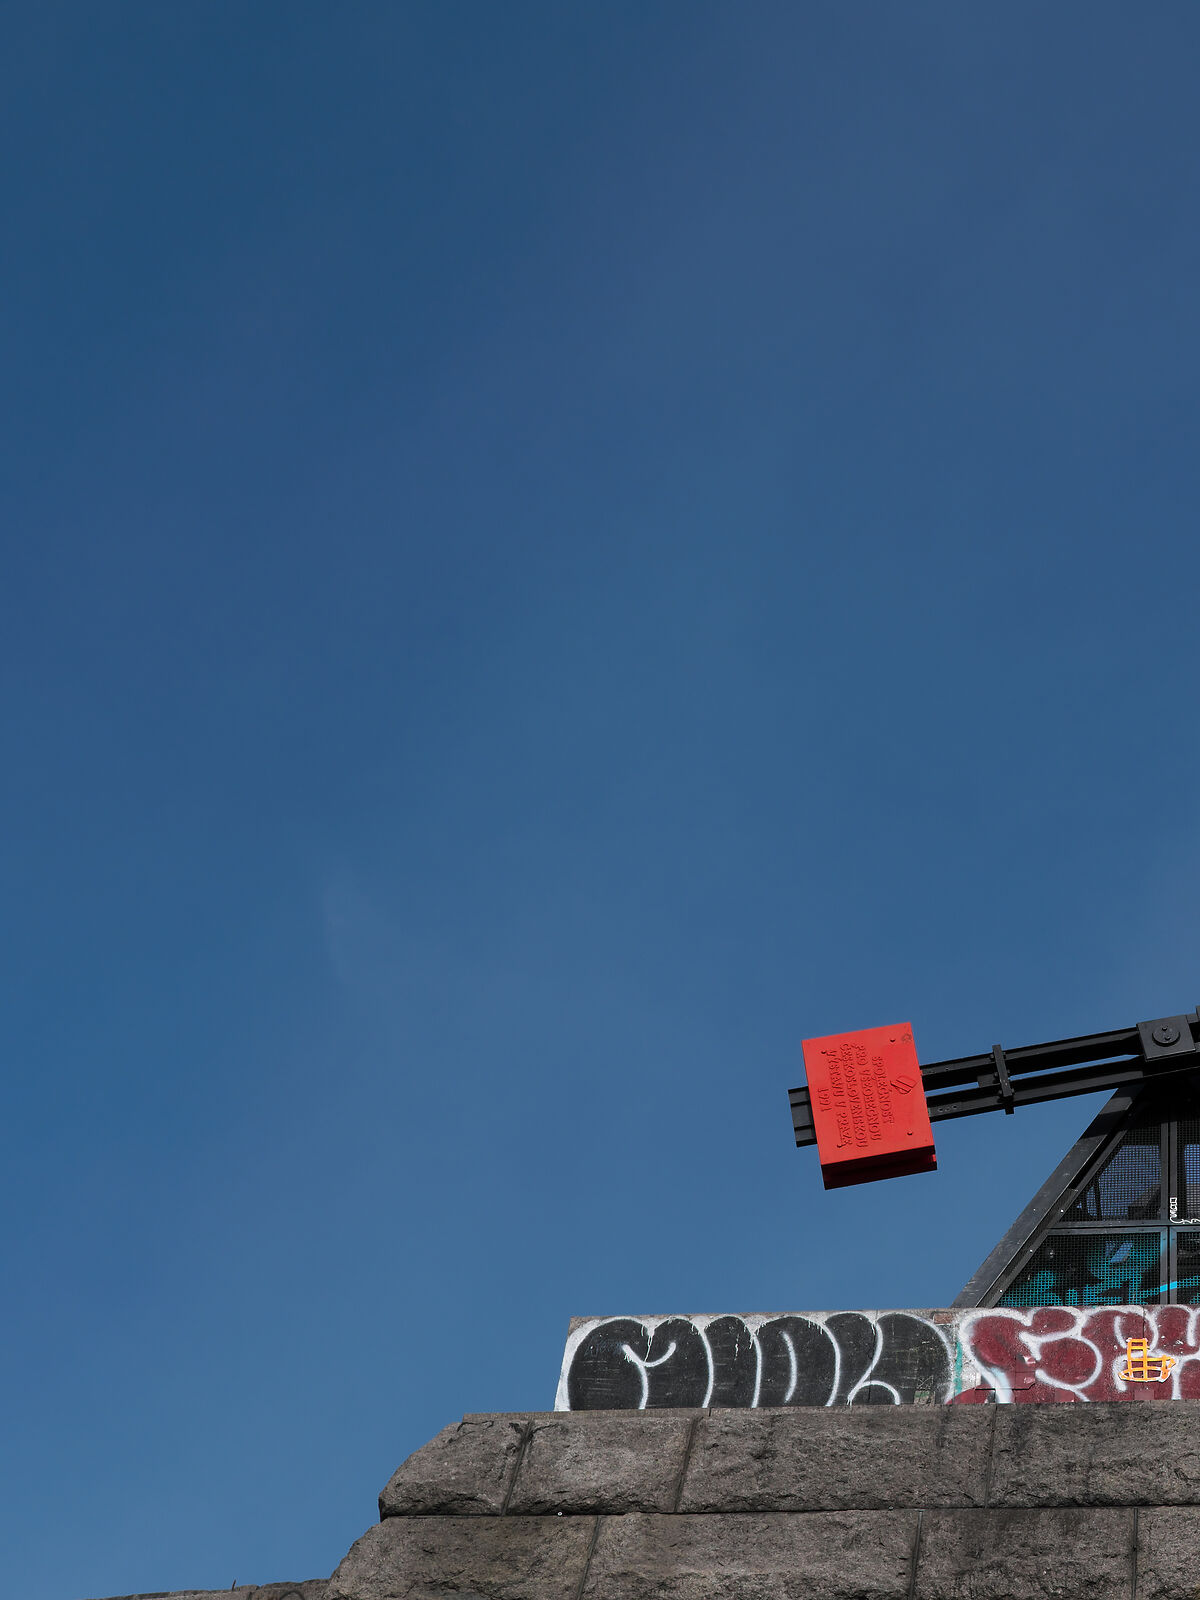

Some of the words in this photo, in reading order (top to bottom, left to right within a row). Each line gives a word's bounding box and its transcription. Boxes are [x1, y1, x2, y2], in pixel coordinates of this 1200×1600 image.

[855, 1045, 868, 1066] PRO
[818, 1088, 832, 1112] 1991
[872, 1056, 895, 1124] SPOLEČNOST
[836, 1112, 852, 1146] PRAZE
